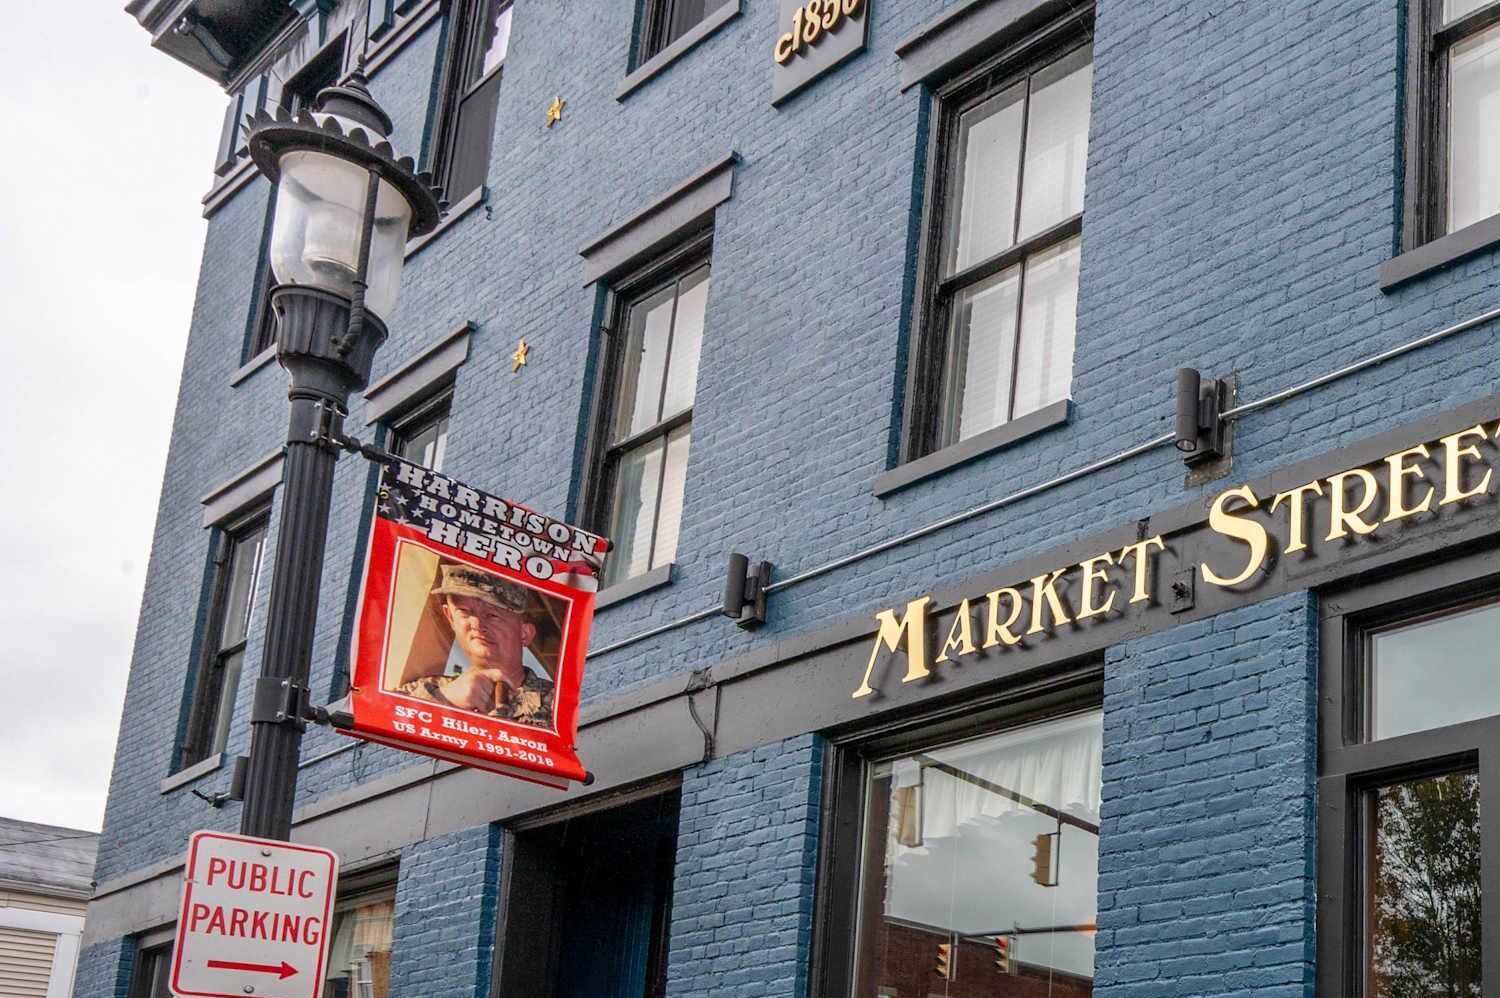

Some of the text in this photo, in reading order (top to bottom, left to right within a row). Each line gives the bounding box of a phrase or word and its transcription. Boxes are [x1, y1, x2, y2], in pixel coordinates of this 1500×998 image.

[397, 462, 599, 555] HARRISON
[419, 494, 572, 562] HOMETOWN
[426, 517, 554, 580] HERO
[852, 535, 1164, 699] MARKET
[392, 720, 416, 734] US
[420, 726, 469, 748] Army
[395, 705, 548, 752] SFC Hiler, Aaron
[207, 856, 315, 898] PUBLIC
[189, 903, 321, 945] PARKING
